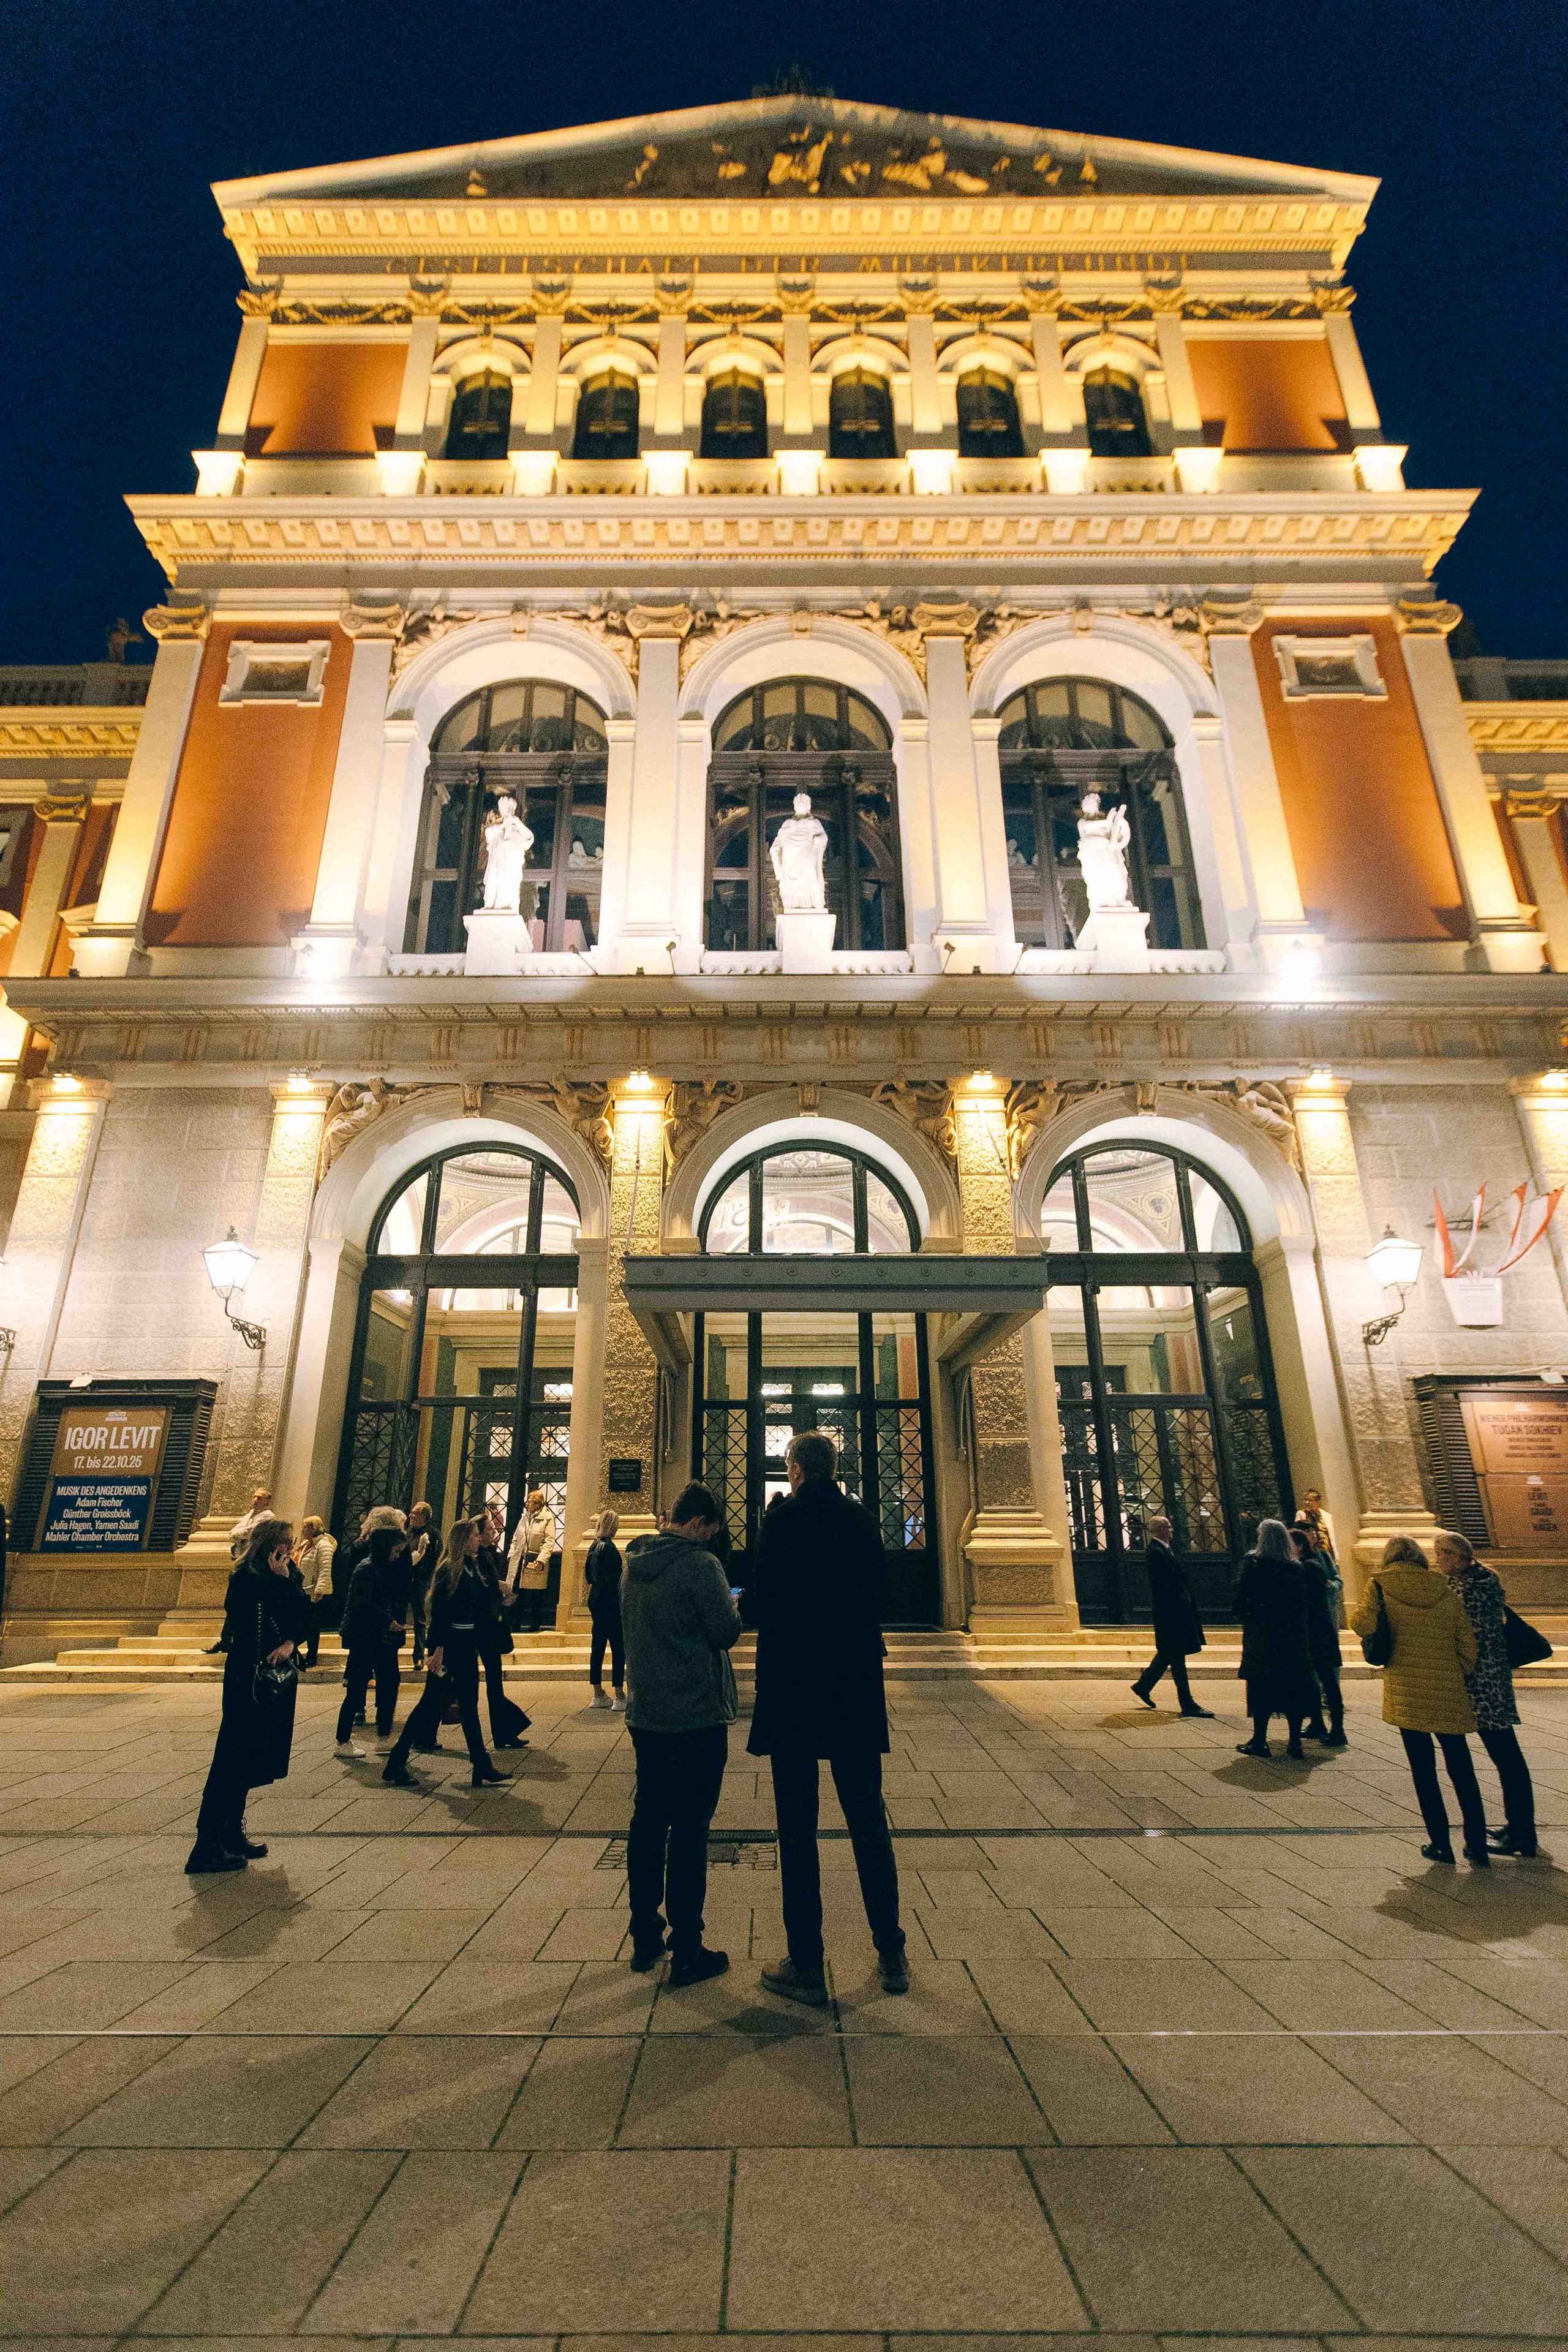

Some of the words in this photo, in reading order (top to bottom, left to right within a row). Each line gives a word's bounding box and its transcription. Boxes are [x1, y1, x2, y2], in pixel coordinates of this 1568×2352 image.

[64, 1427, 108, 1450] IGOR
[109, 1426, 161, 1449] LEVIT
[74, 1456, 85, 1468] 17.
[86, 1456, 101, 1468] bis
[102, 1455, 142, 1468] 22.10.25
[56, 1485, 80, 1496] MUSIK
[80, 1485, 95, 1496] DES
[95, 1485, 147, 1495] ANGEDENKENS
[75, 1497, 97, 1507] Adam
[97, 1497, 124, 1507] Fischer
[63, 1509, 92, 1518] Günther
[92, 1508, 132, 1518] Groissböck
[50, 1520, 68, 1530] Julia
[69, 1520, 93, 1531] Hagen,
[95, 1520, 118, 1530] Yamen
[119, 1520, 140, 1529] Saadi
[45, 1531, 70, 1542] Mahler
[71, 1531, 104, 1541] Chamber
[104, 1531, 138, 1541] Orchestra
